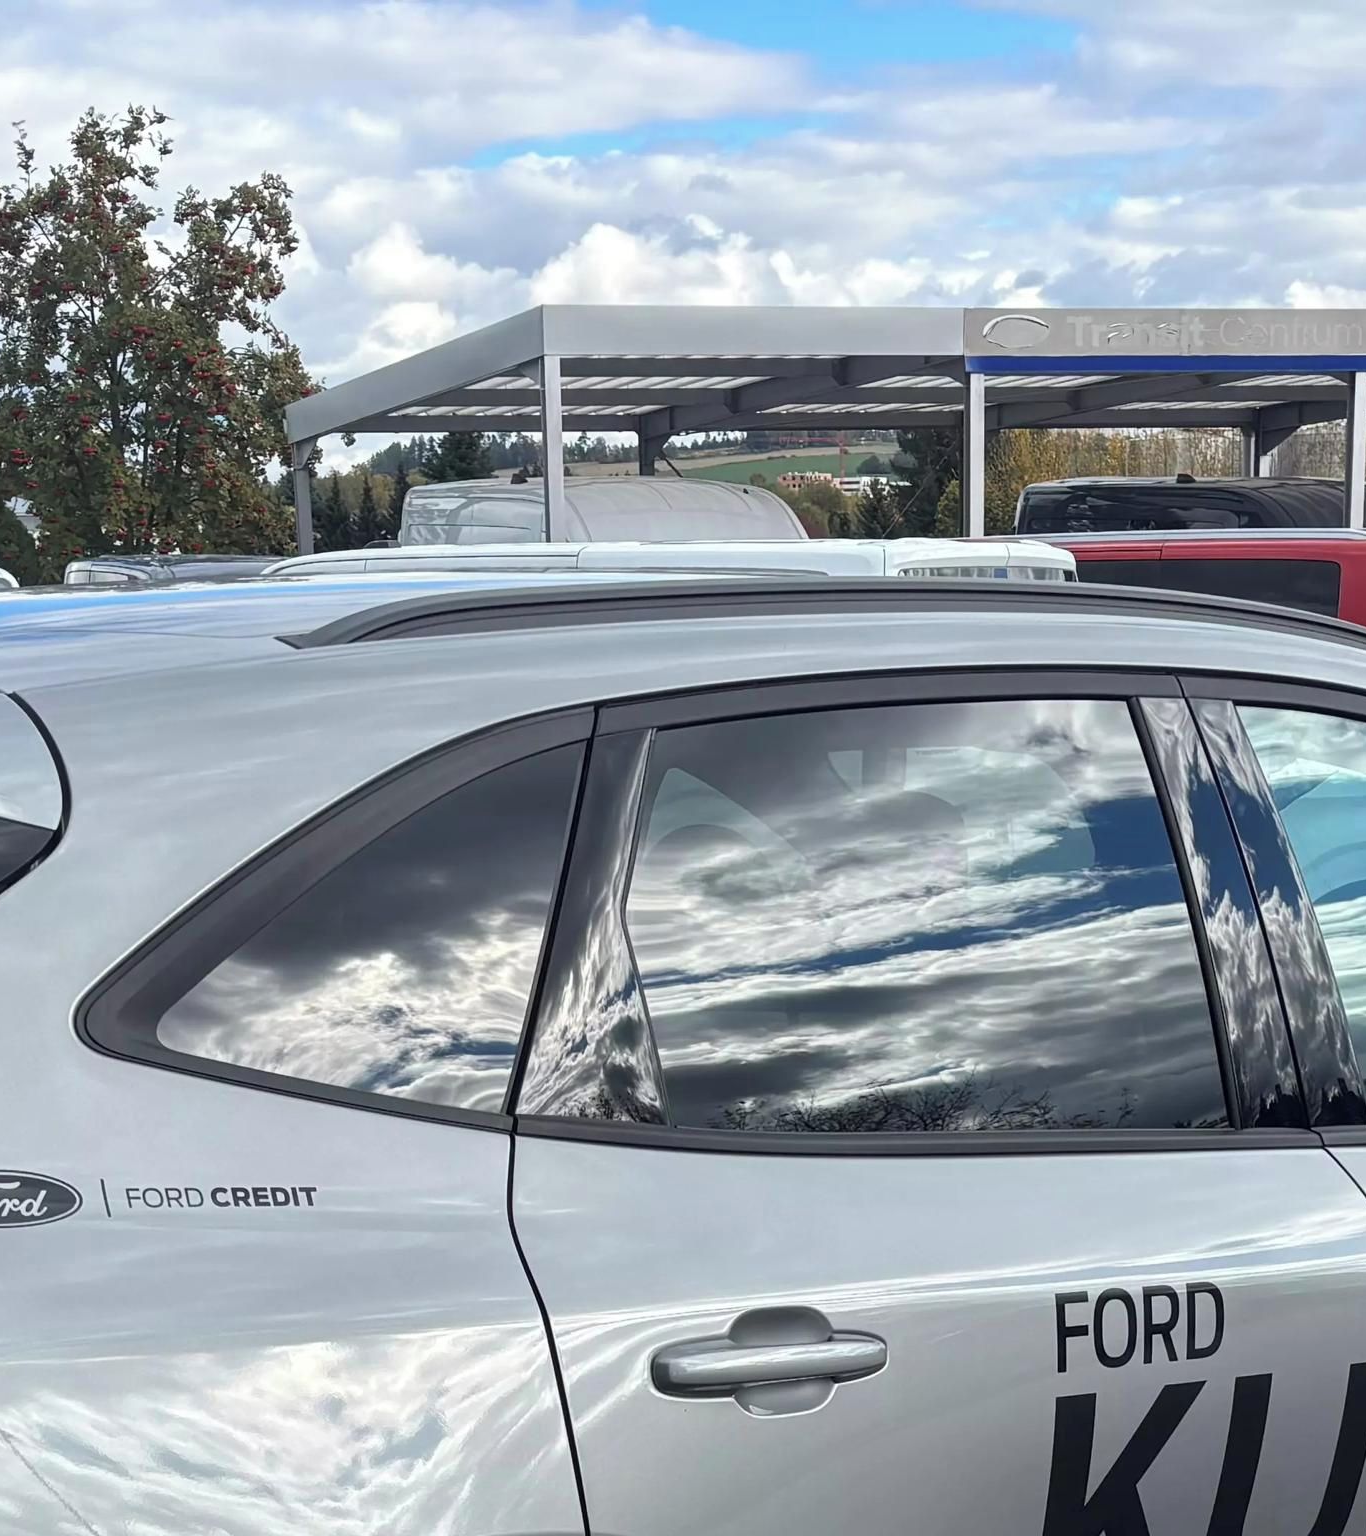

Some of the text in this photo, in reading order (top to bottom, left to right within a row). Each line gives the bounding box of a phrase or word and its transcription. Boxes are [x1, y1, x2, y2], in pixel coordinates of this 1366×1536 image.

[124, 1185, 318, 1209] FORD CREDIT
[1054, 1280, 1226, 1374] FORD
